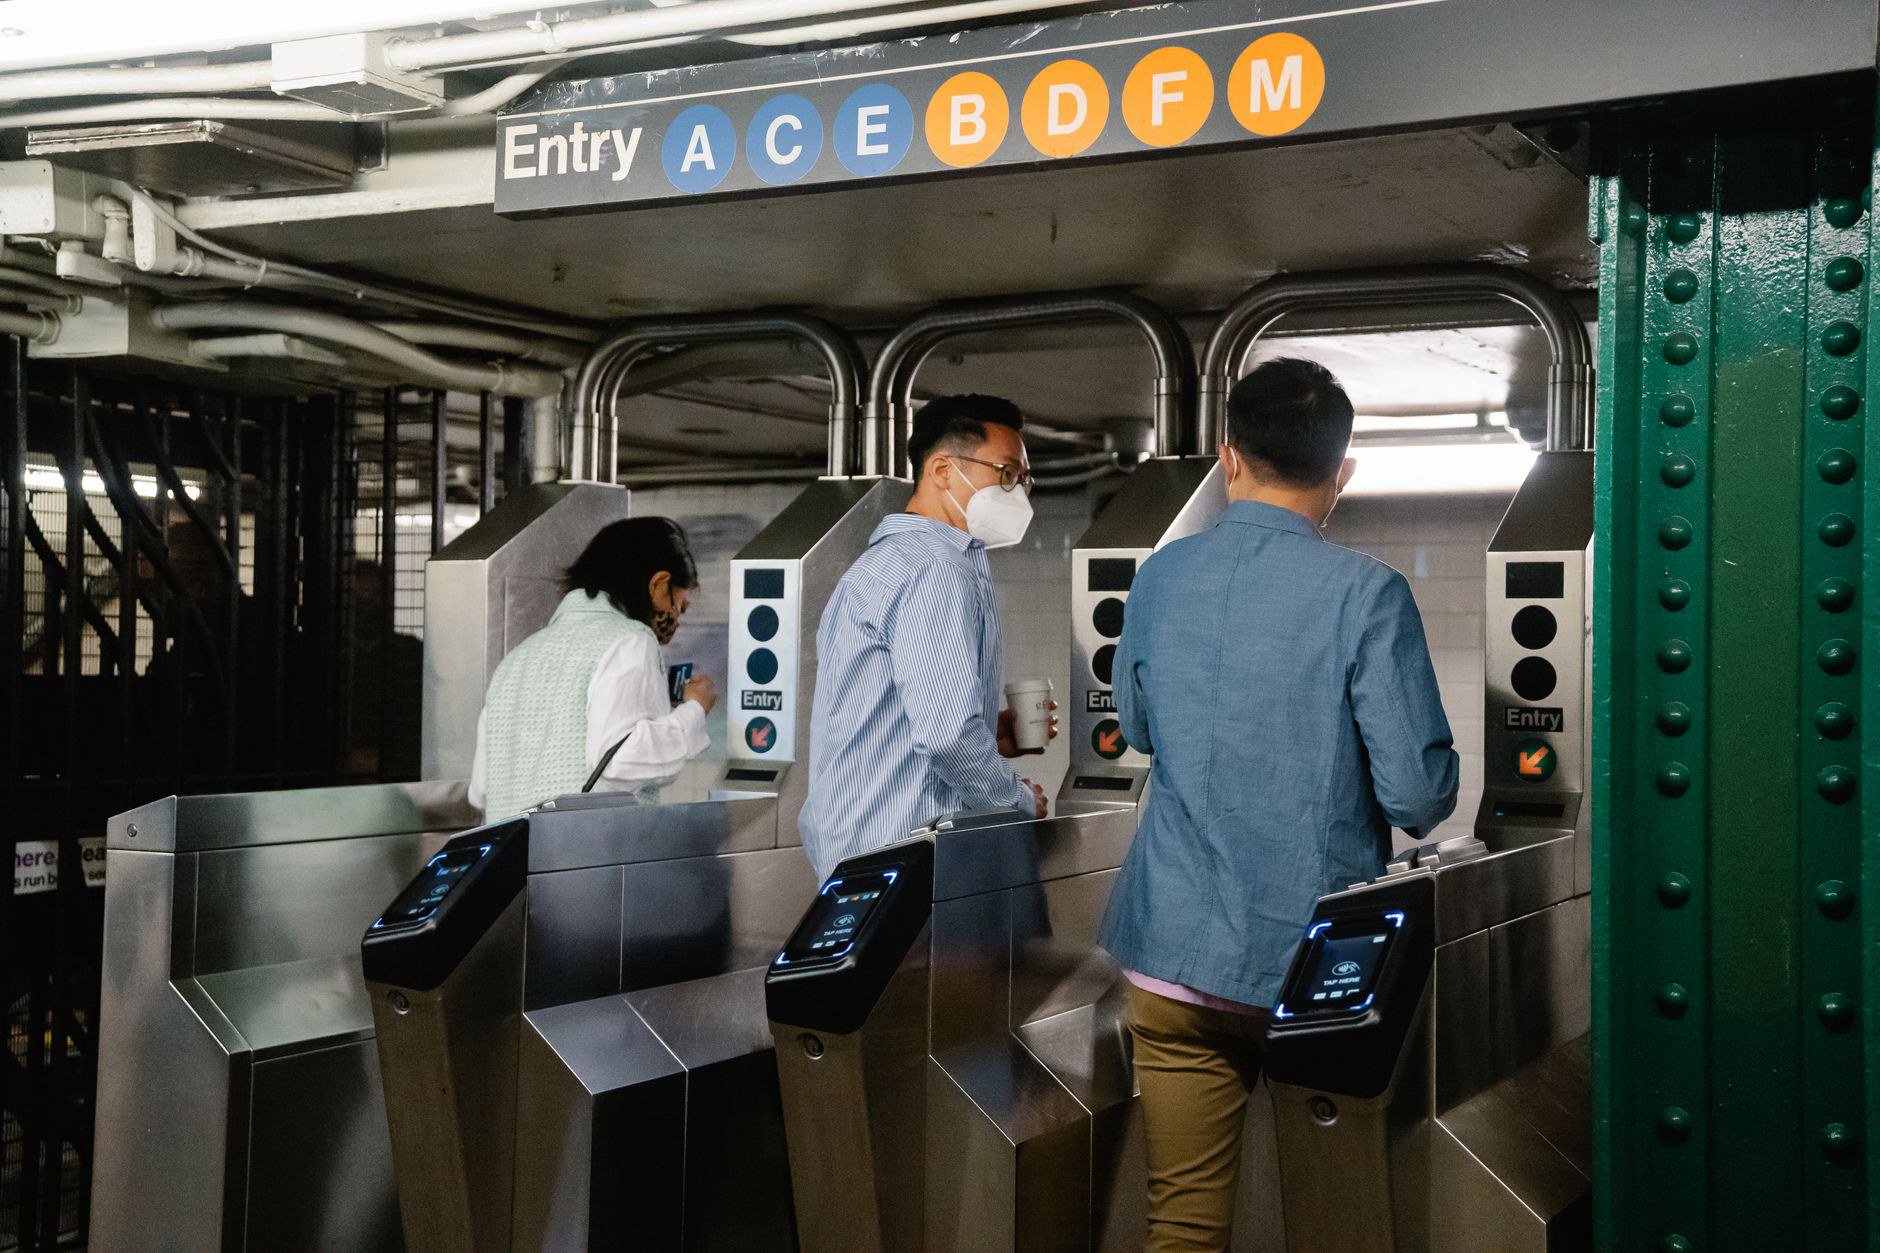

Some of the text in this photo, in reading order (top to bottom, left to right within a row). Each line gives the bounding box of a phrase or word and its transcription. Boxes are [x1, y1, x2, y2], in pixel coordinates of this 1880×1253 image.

[503, 55, 1302, 182] Entry A C E B D F M
[743, 691, 782, 710] Entry
[1088, 691, 1117, 708] Ent
[1507, 708, 1561, 731] Entry
[24, 875, 45, 887] run
[1339, 976, 1360, 984] HERE
